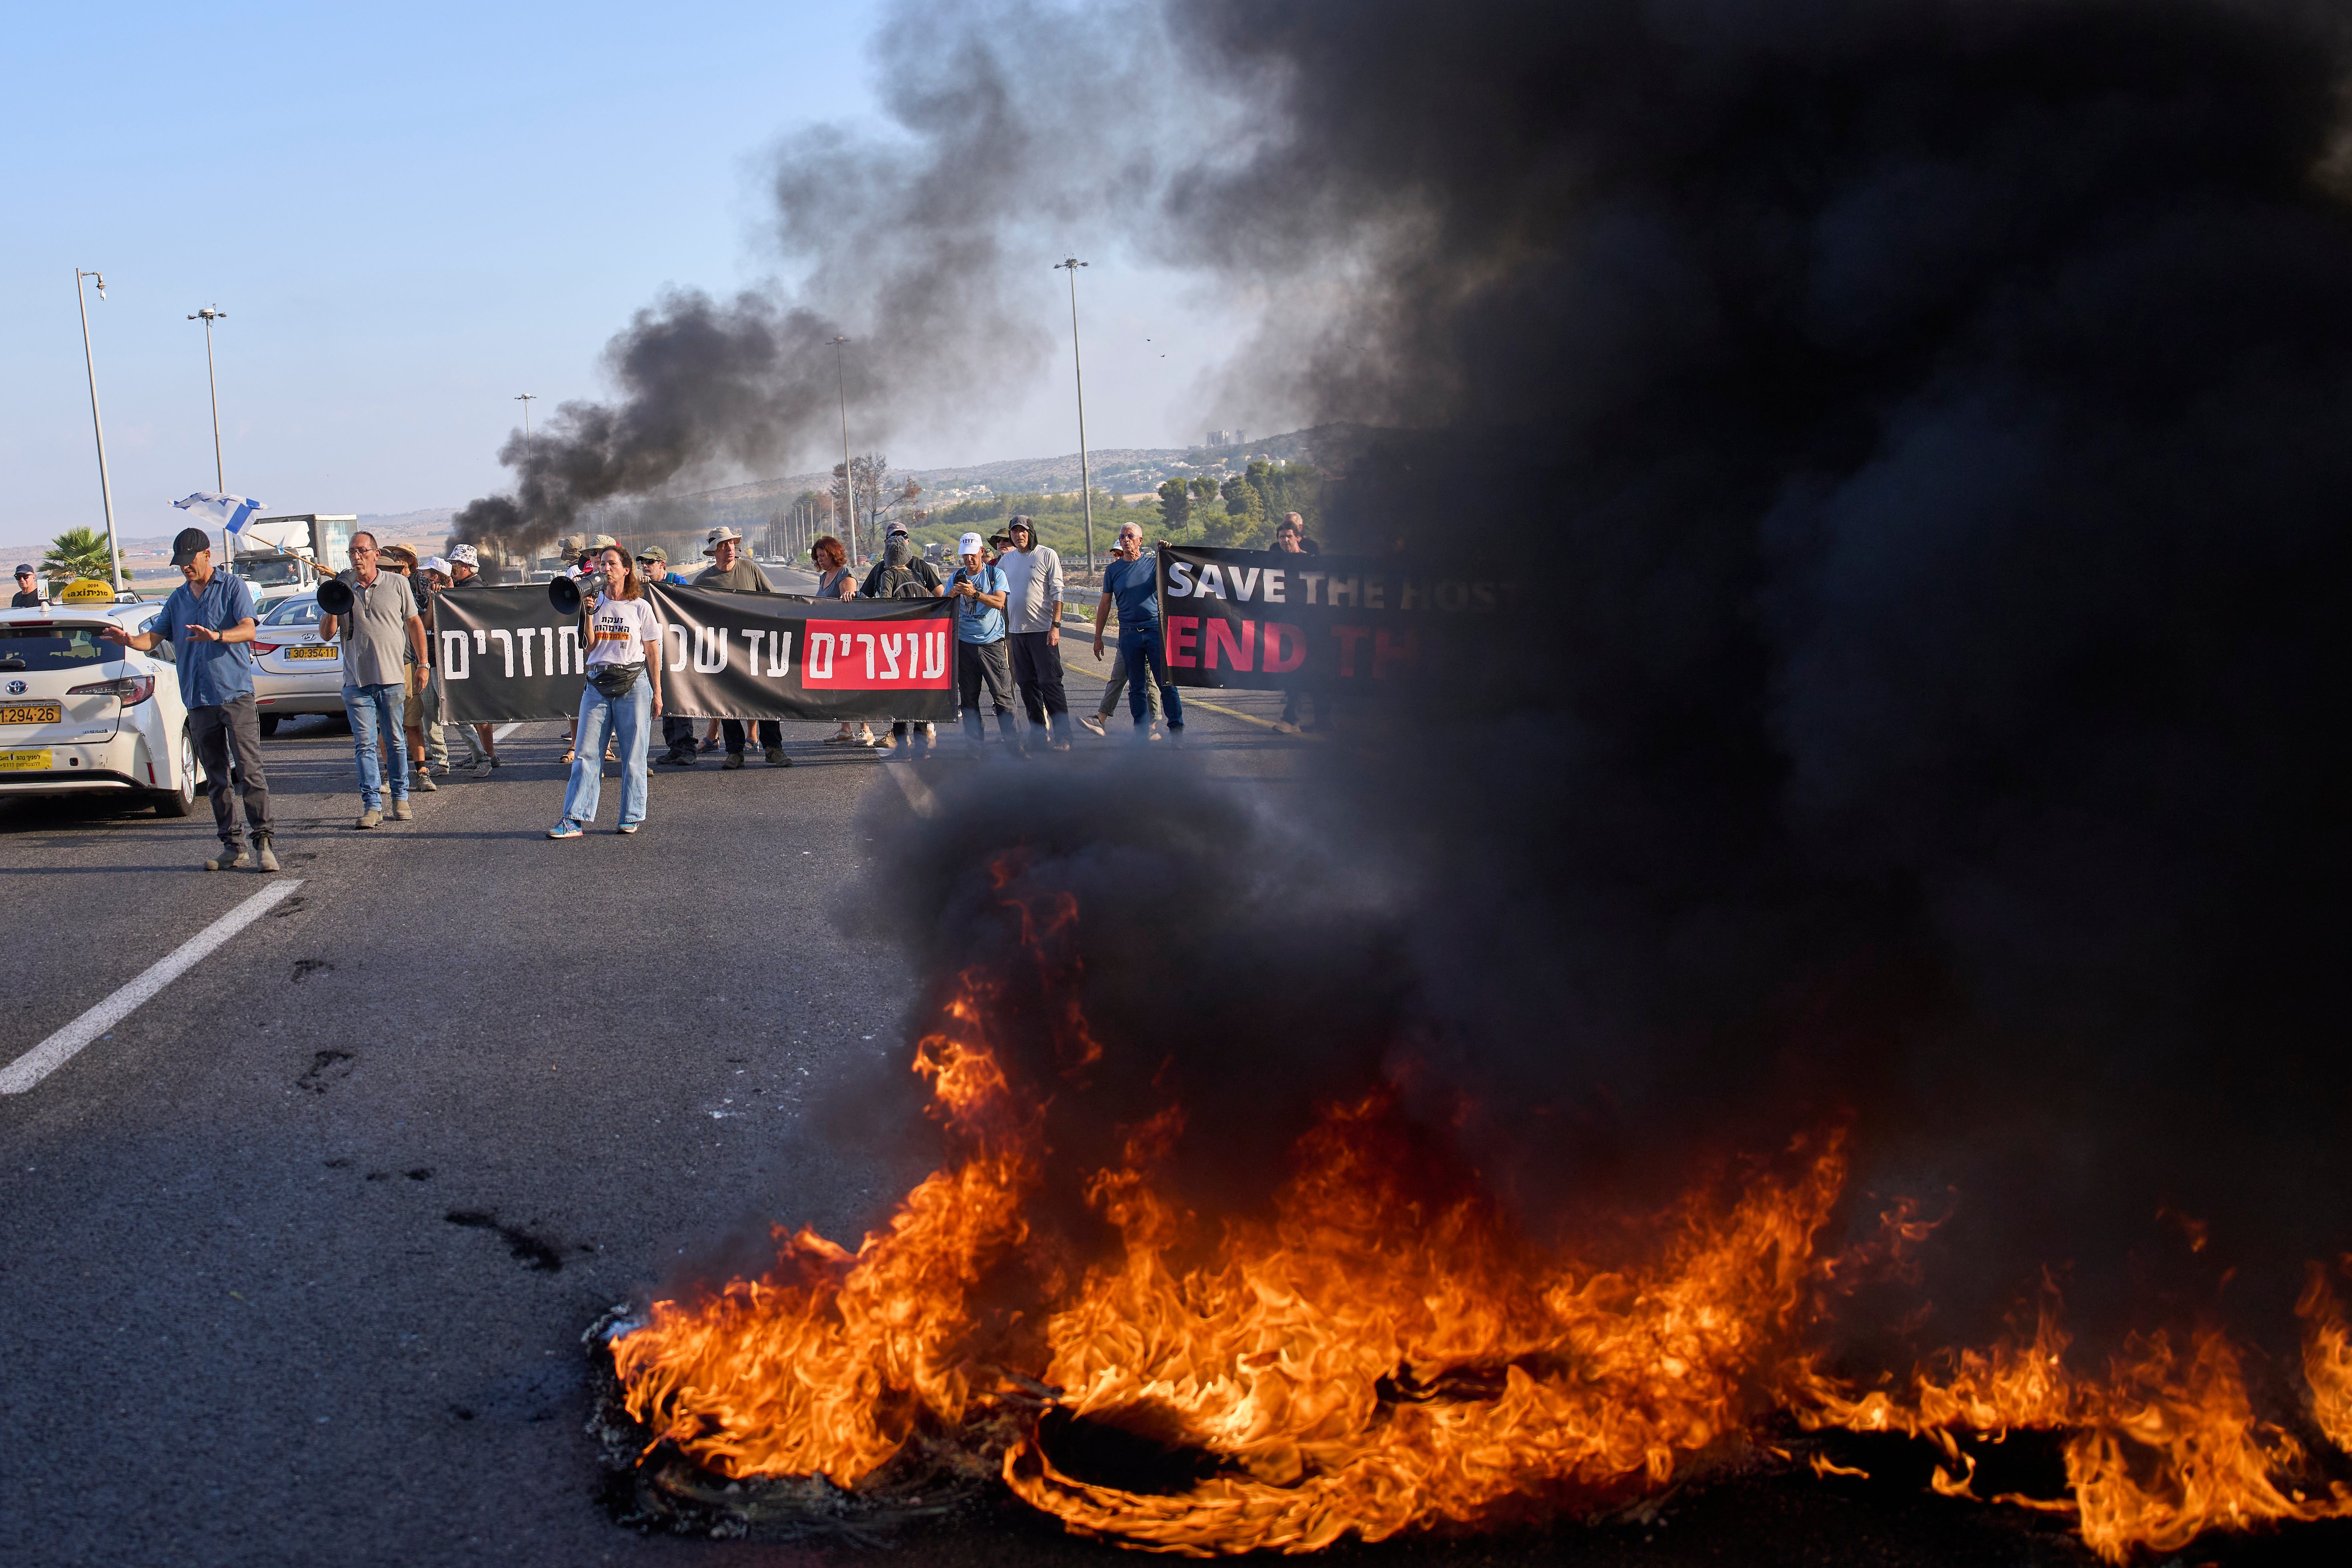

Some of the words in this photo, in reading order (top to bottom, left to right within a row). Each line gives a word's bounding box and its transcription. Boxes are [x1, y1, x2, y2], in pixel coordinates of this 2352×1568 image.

[67, 588, 86, 597] taxi
[1167, 561, 1285, 603] SAVE
[1299, 571, 1384, 608] THE
[442, 626, 584, 680] חוזרים
[741, 629, 792, 677] עד
[809, 631, 945, 680] עוצרים
[1166, 615, 1307, 673] END
